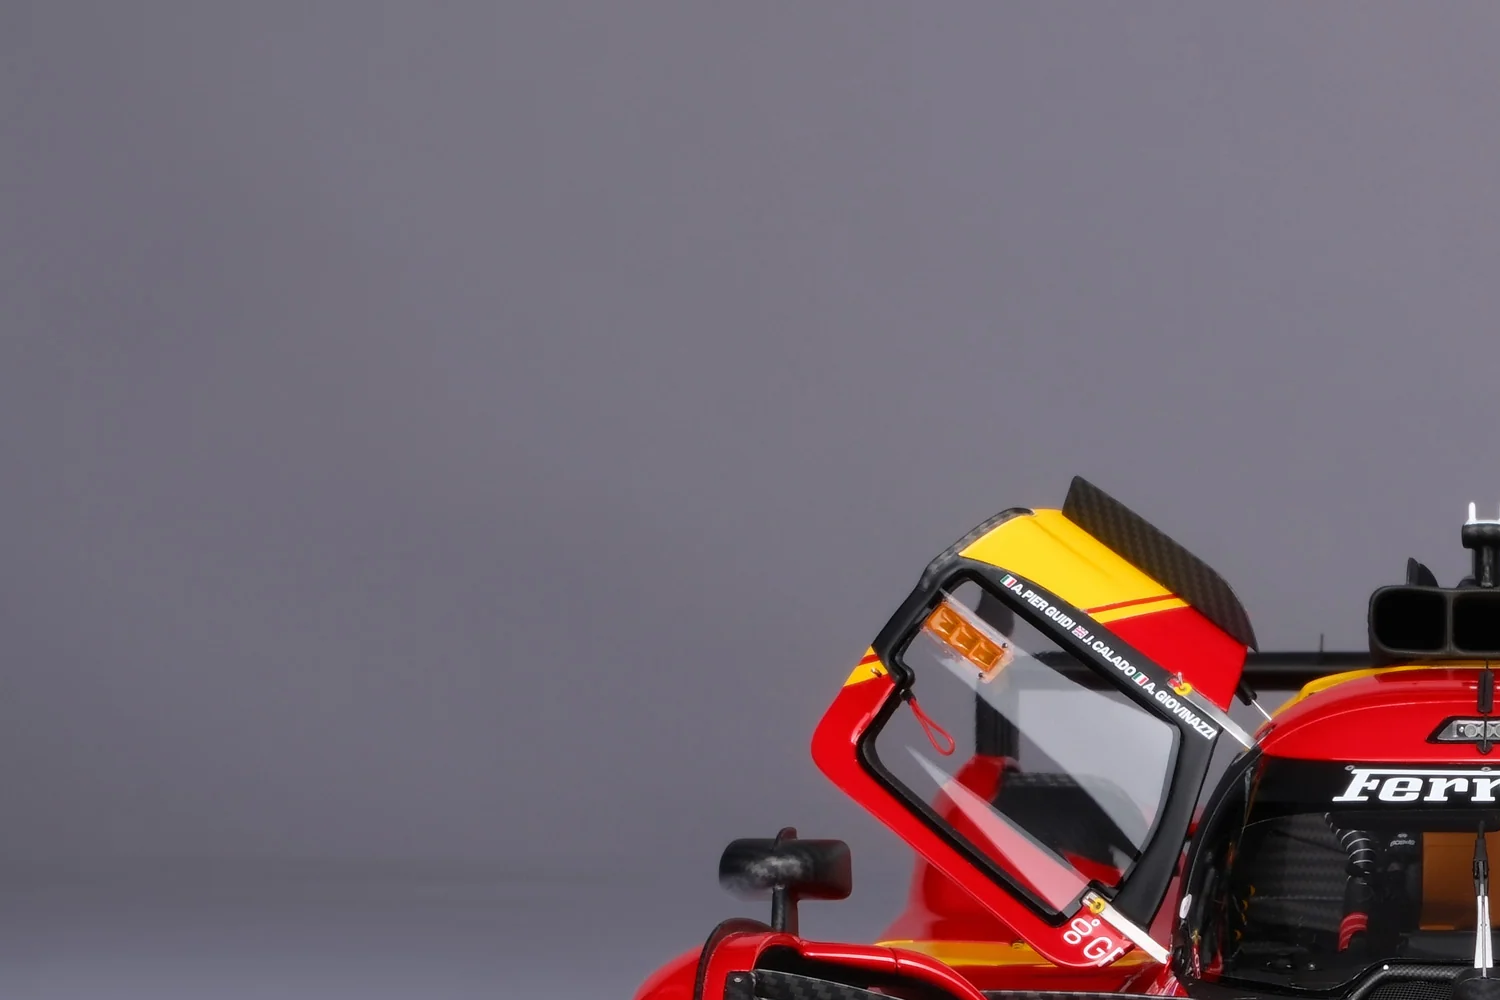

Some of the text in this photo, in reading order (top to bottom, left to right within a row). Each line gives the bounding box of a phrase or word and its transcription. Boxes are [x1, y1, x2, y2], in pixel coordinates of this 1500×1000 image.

[1010, 583, 1218, 740] A. PIER GUIDI J. CALADO A. GIOVINAZZI
